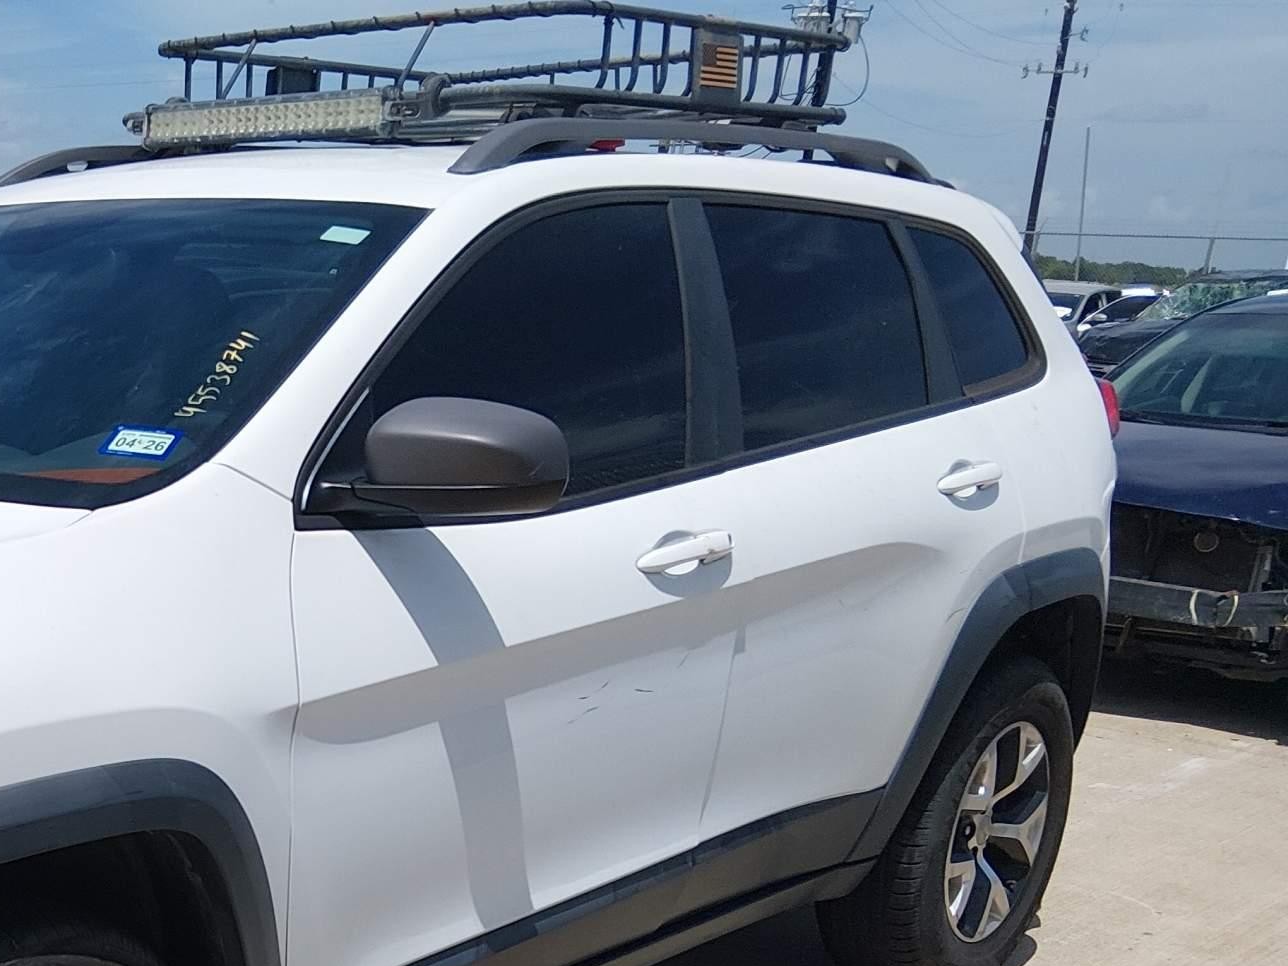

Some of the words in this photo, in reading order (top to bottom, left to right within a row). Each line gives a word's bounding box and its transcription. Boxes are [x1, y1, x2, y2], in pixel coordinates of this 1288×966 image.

[174, 330, 260, 417] 45538741
[115, 437, 138, 448] 04
[142, 440, 167, 452] 26
